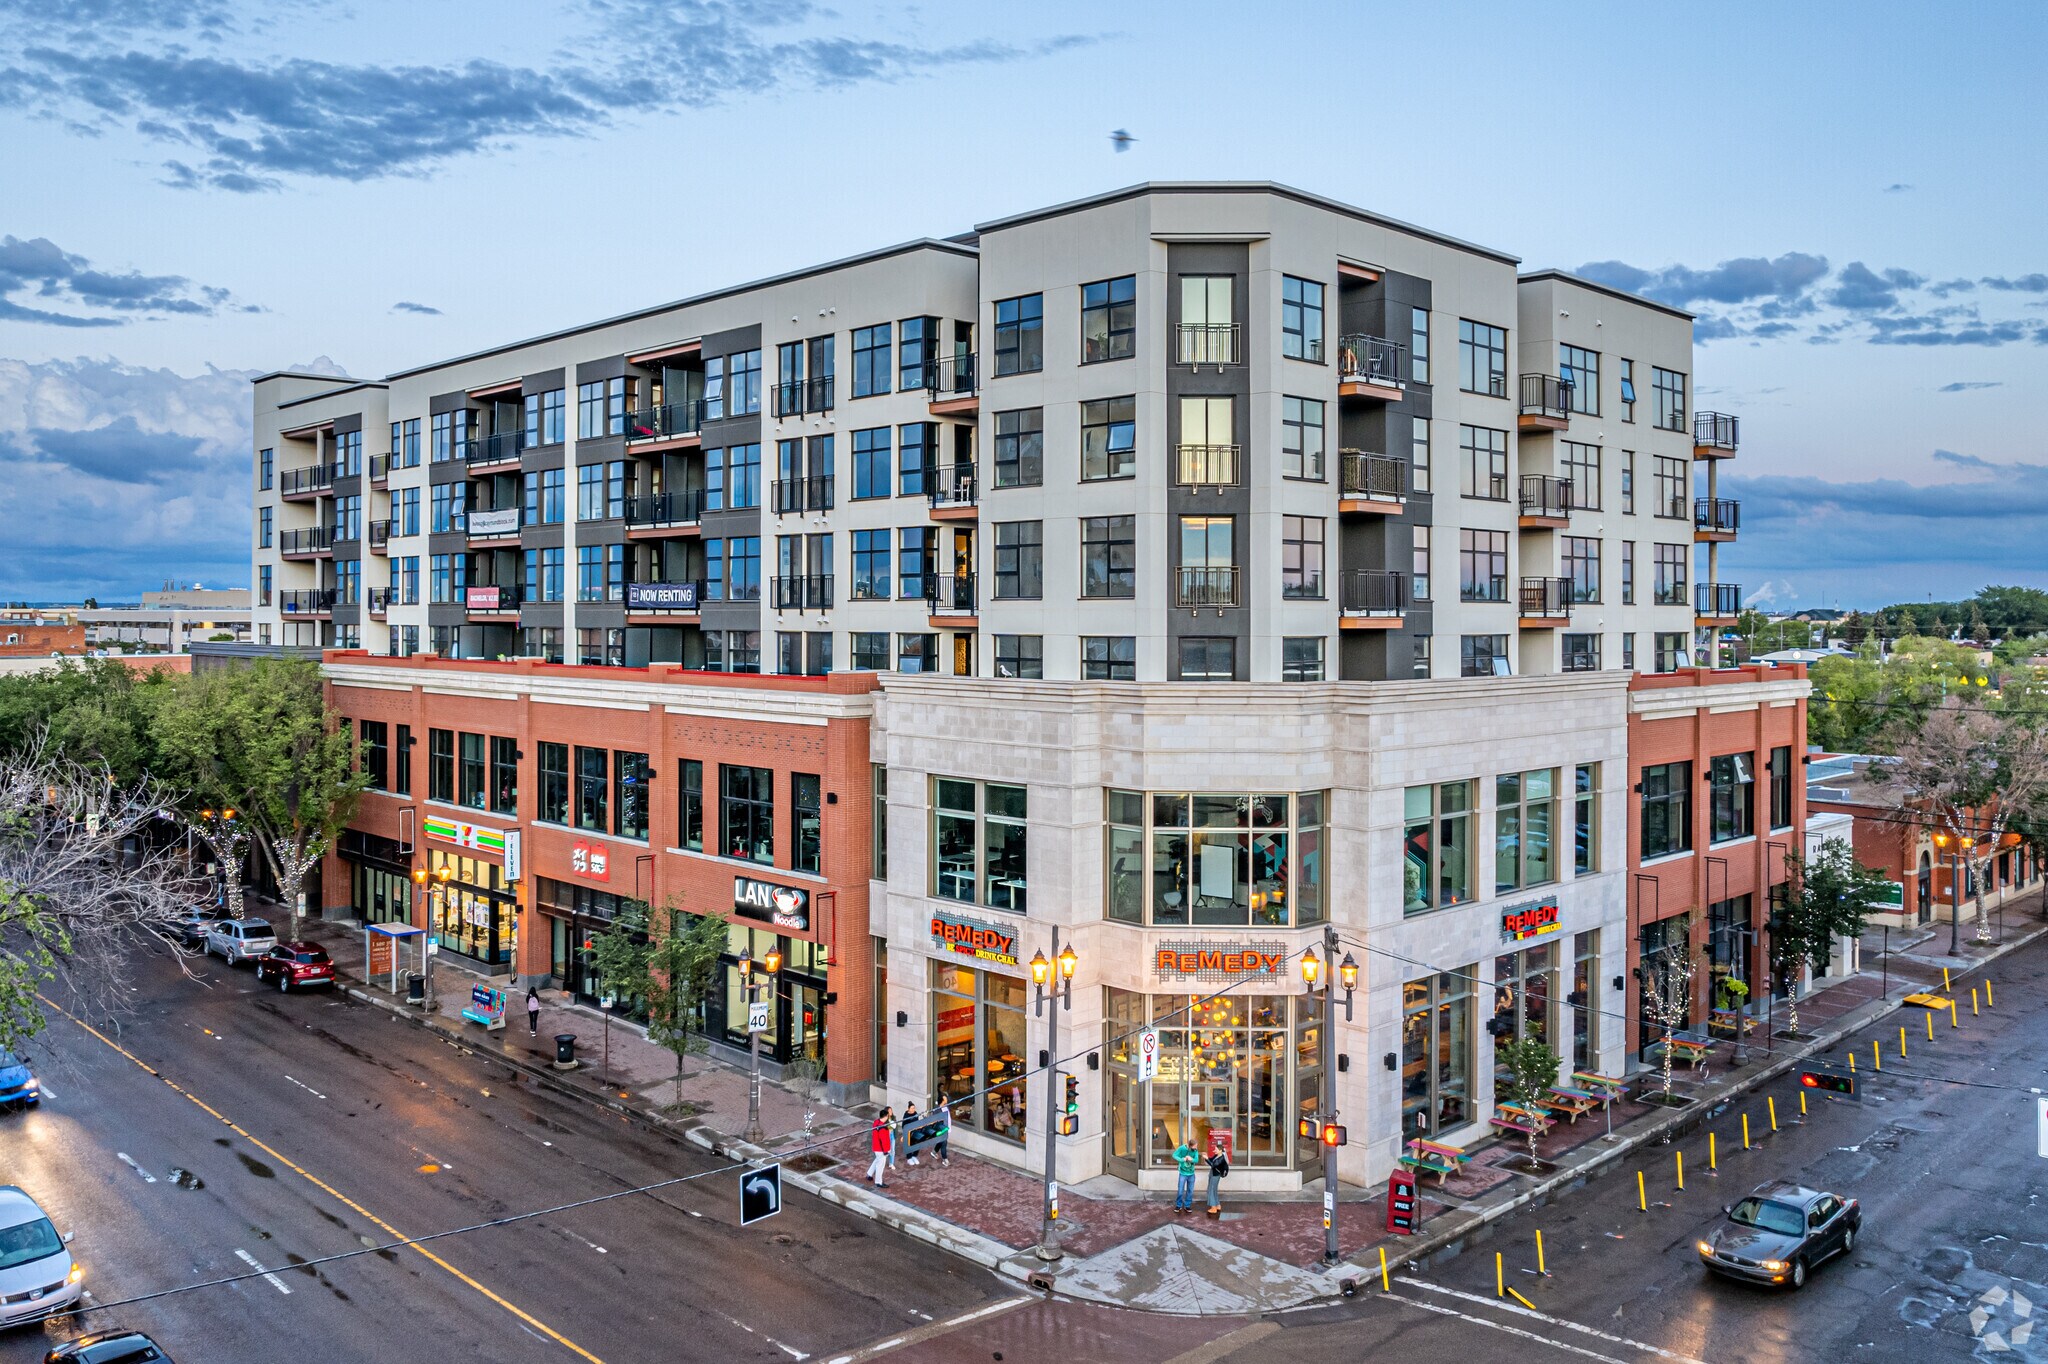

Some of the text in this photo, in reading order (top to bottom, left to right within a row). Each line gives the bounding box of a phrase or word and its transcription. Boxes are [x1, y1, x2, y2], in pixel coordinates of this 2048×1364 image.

[640, 589, 657, 602] NOW
[658, 589, 692, 602] RENTING
[735, 879, 772, 908] LAN
[774, 912, 801, 929] Noodle
[1505, 905, 1560, 933] REMEDY
[931, 918, 1011, 954] REMEDY
[946, 942, 955, 952] BE
[955, 945, 975, 957] SPICY
[975, 949, 997, 962] DRINK
[1157, 950, 1283, 973] REMEDY
[750, 1014, 766, 1028] 40
